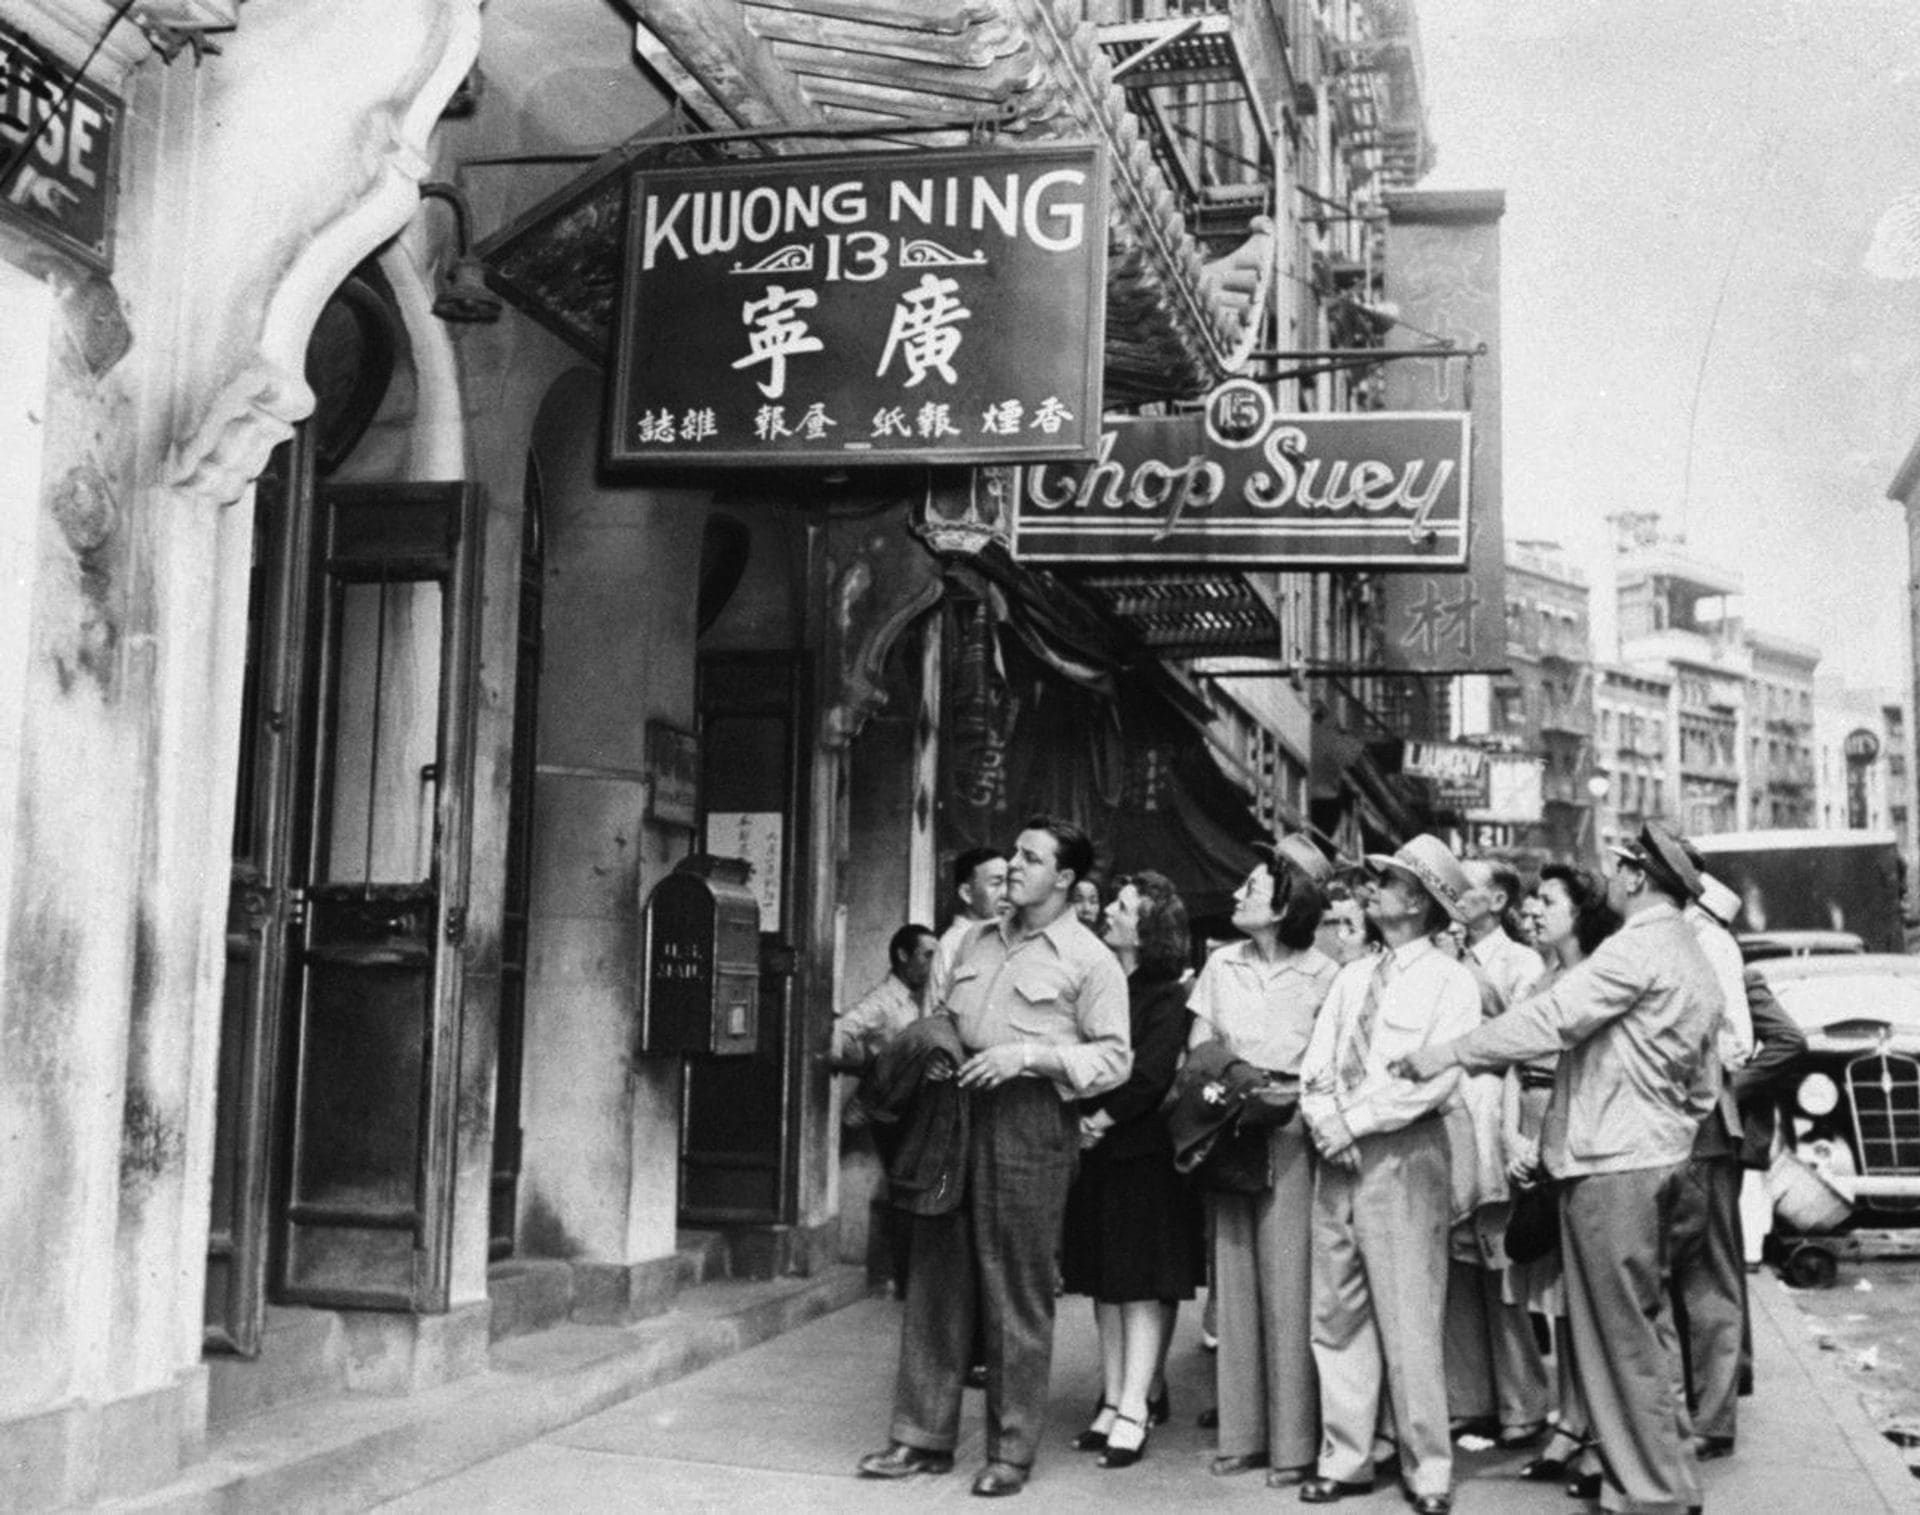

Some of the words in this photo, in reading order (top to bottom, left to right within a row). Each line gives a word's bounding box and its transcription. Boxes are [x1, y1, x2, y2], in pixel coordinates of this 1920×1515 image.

[641, 181, 868, 271] KWONG
[889, 168, 1087, 253] NING
[825, 230, 890, 282] 13
[1218, 391, 1260, 429] 15
[1027, 429, 1226, 543] Chop
[1244, 425, 1456, 544] Suey
